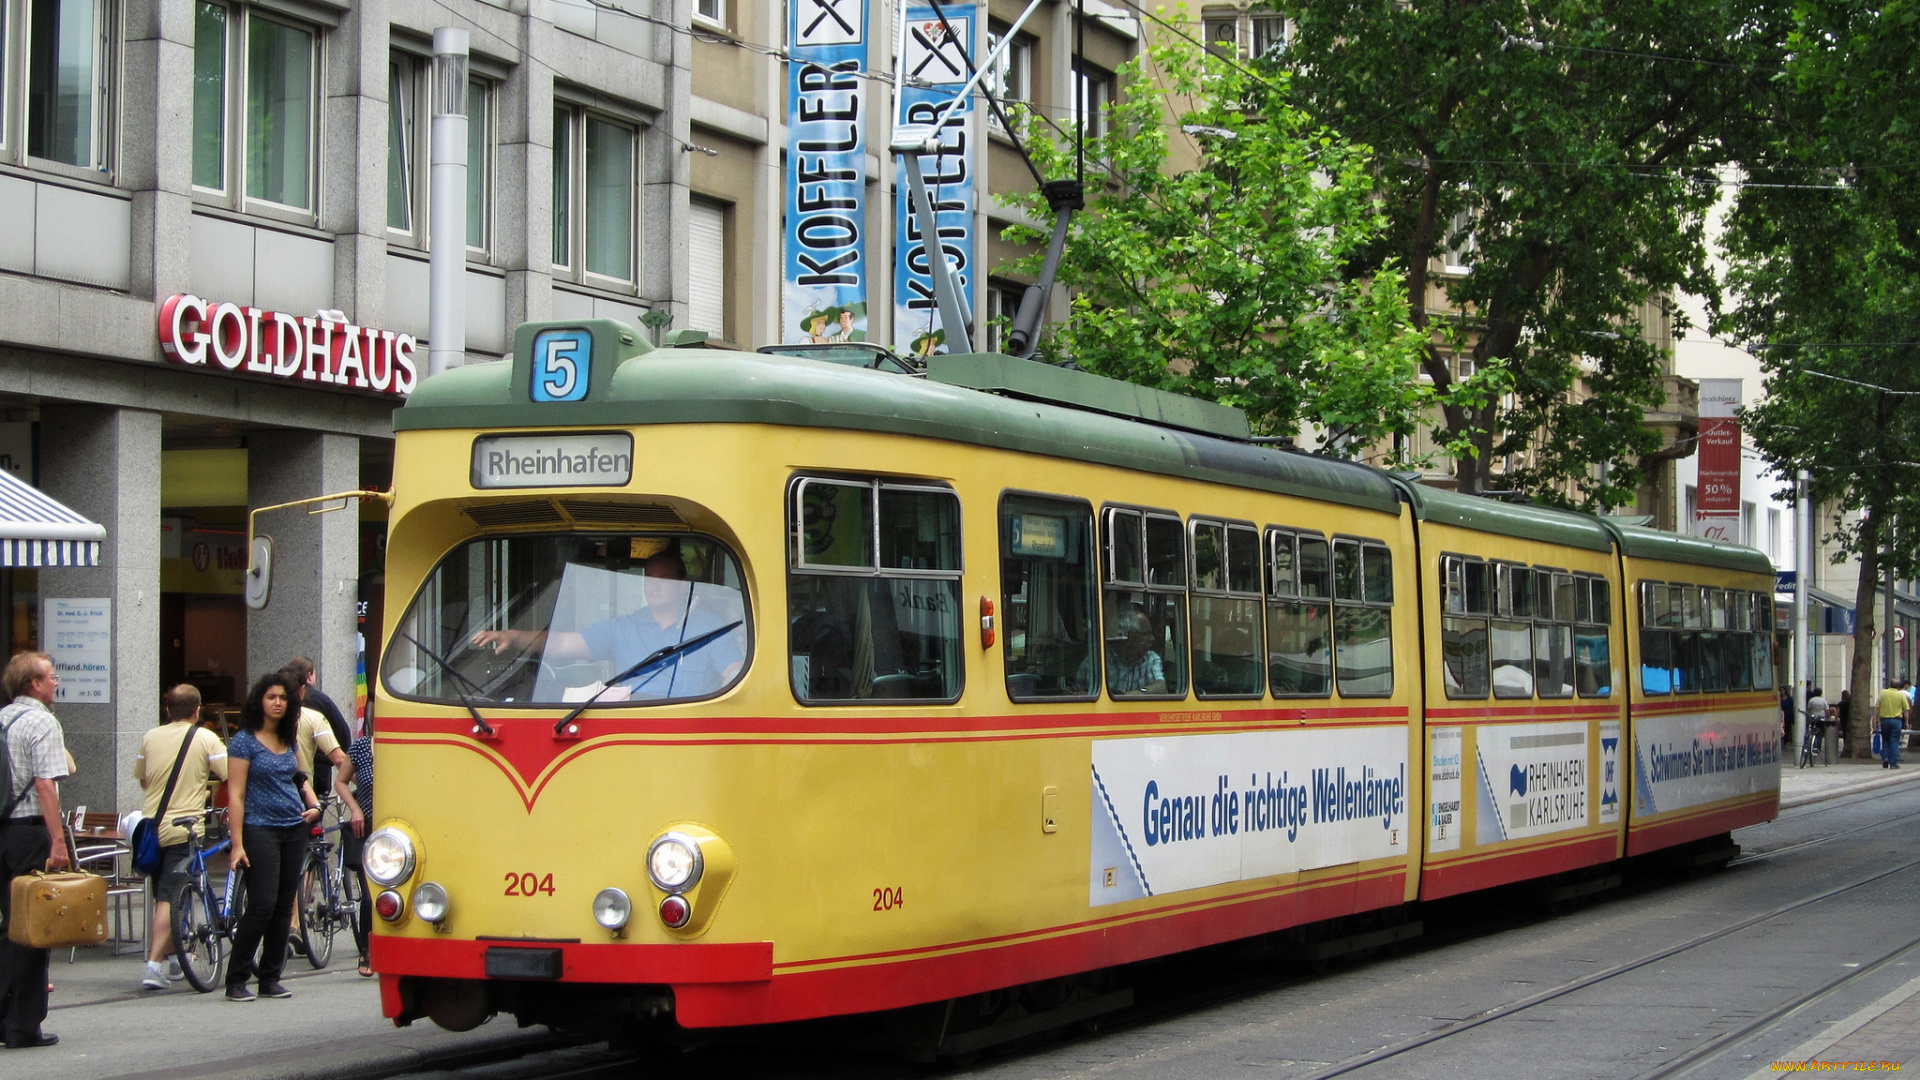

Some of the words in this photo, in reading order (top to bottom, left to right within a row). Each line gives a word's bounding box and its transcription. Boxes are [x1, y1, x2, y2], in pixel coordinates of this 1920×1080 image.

[797, 58, 860, 287] KOFFLER
[166, 293, 417, 395] GOLDHAUS
[543, 338, 579, 399] 5
[1706, 438, 1734, 446] Verkauf
[1707, 429, 1733, 437] Outlet-
[489, 447, 629, 476] Rheinhafen
[1529, 759, 1585, 793] RHEINHAFEN
[1650, 742, 1691, 784] Schwimmen
[1692, 738, 1703, 777] Sie
[1143, 779, 1206, 847] Genau
[1211, 774, 1239, 837] die
[1244, 770, 1307, 843] richtige
[1312, 762, 1404, 831] Wellenlänge!
[1529, 791, 1585, 827] KARLSRUHE
[504, 872, 556, 897] 204
[873, 886, 904, 912] 204
